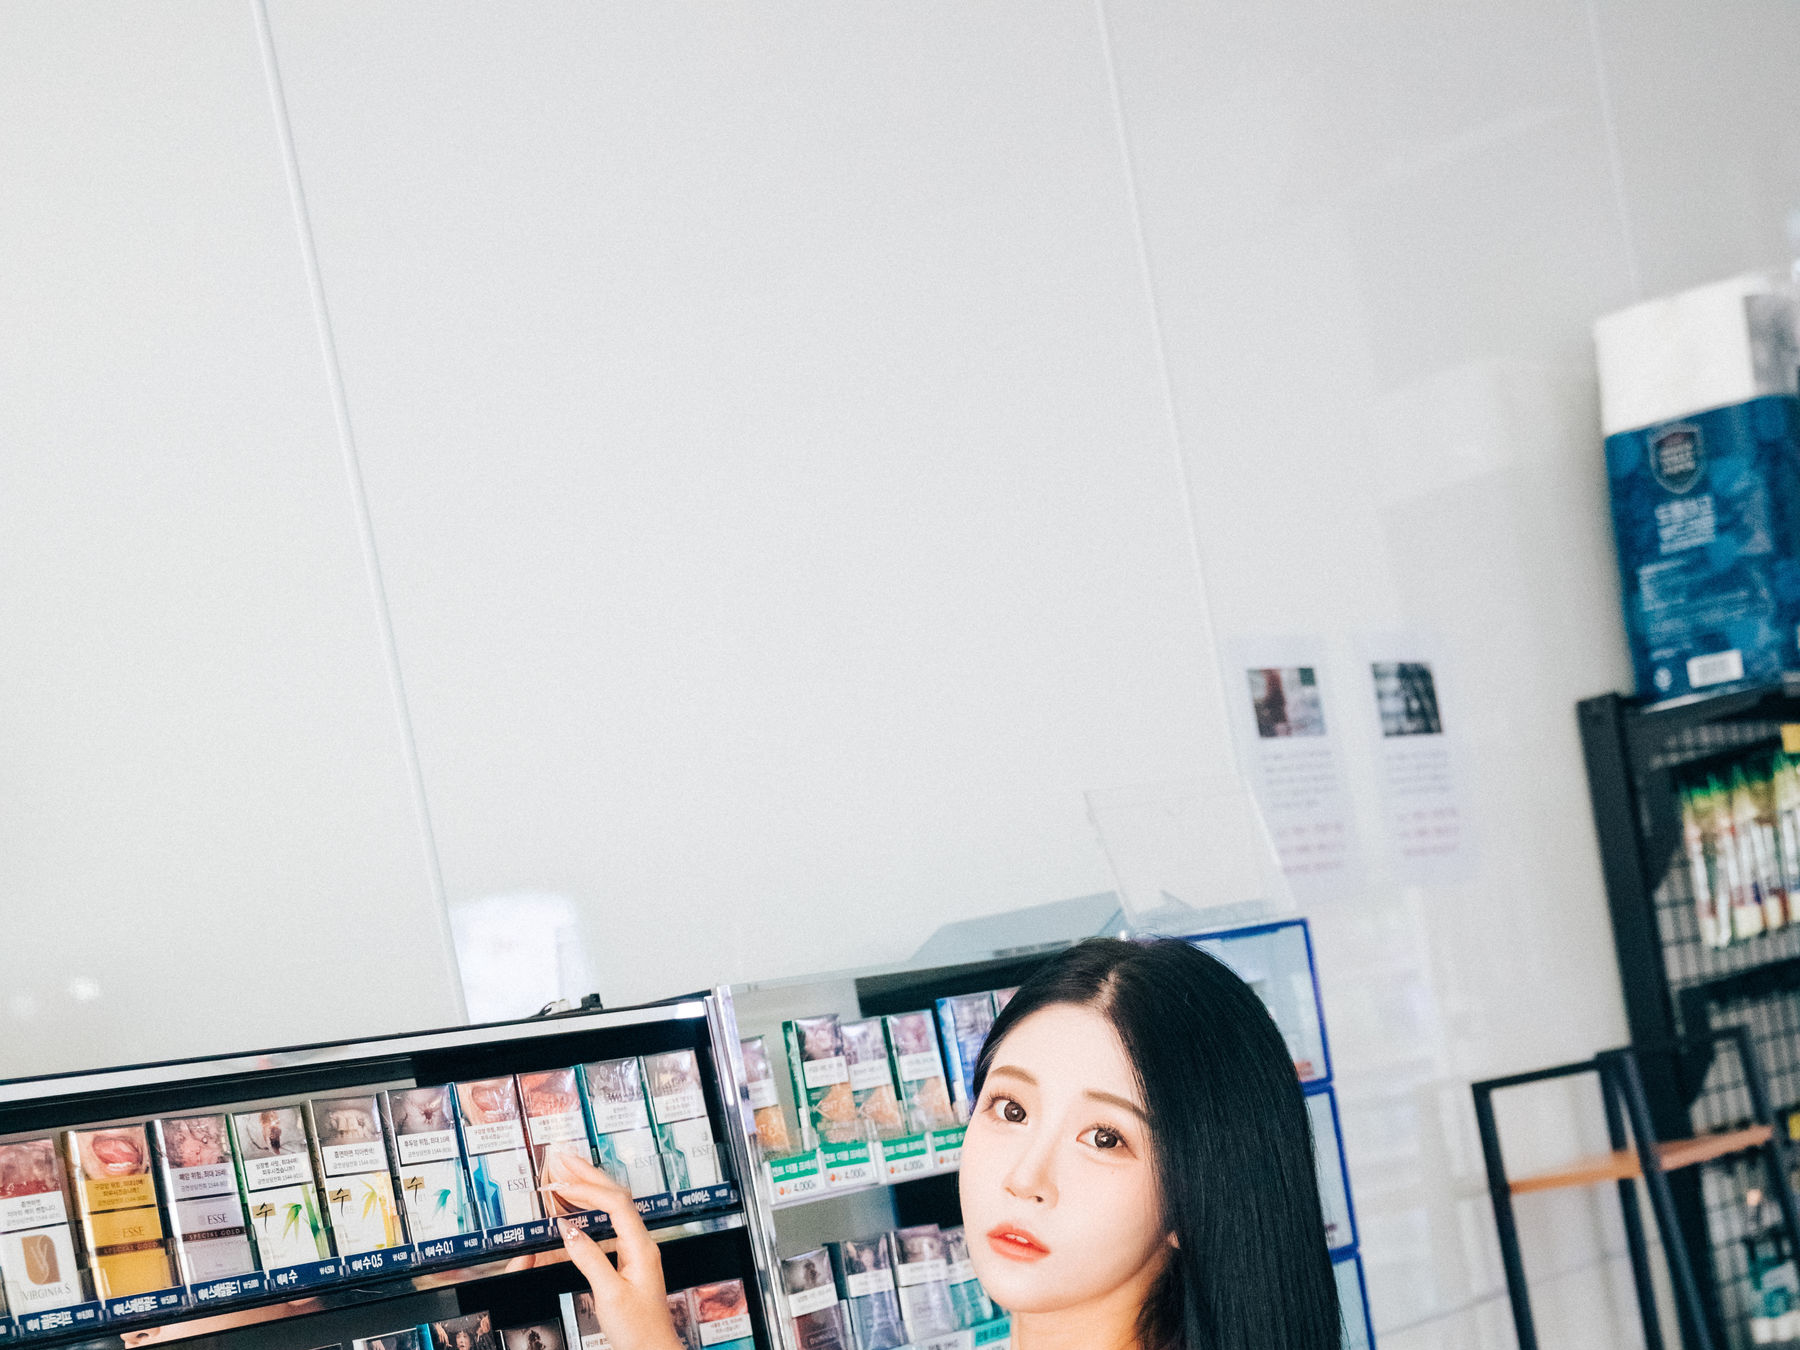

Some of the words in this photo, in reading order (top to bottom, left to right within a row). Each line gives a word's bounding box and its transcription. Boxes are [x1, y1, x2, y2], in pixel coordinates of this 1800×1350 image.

[507, 1178, 529, 1192] ESSE
[207, 1214, 228, 1224] ESSE
[122, 1227, 145, 1238] ESSE
[222, 1228, 241, 1236] GOLD
[288, 1269, 298, 1284] 수
